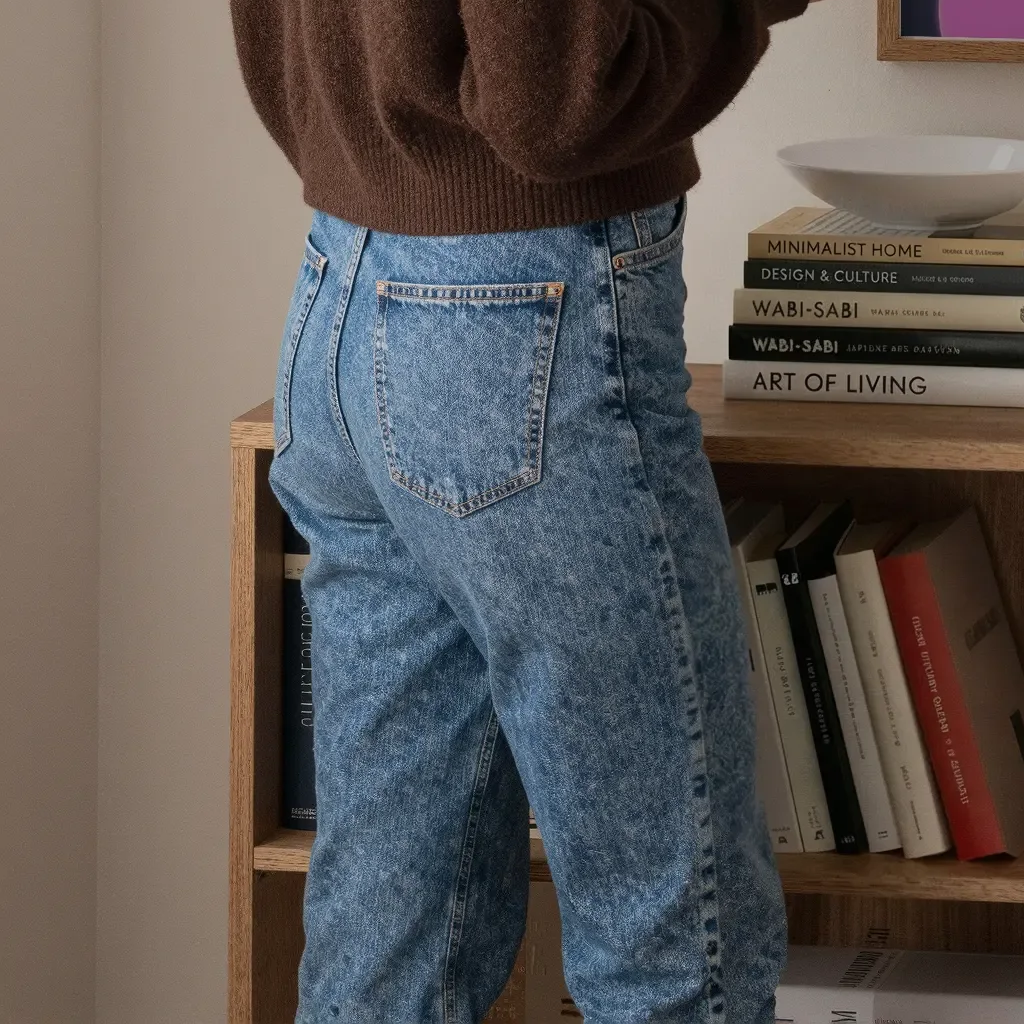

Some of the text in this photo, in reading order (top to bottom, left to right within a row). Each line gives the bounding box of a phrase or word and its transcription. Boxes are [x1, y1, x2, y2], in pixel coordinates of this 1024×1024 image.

[767, 240, 867, 256] MINIMALIST
[872, 242, 922, 258] HOME
[761, 267, 814, 282] DESIGN
[820, 270, 829, 281] &
[834, 270, 897, 283] CULTURE
[752, 300, 857, 318] WABI-SABI
[753, 338, 838, 353] WABI-SABI
[753, 372, 926, 395] ART OF LIVING
